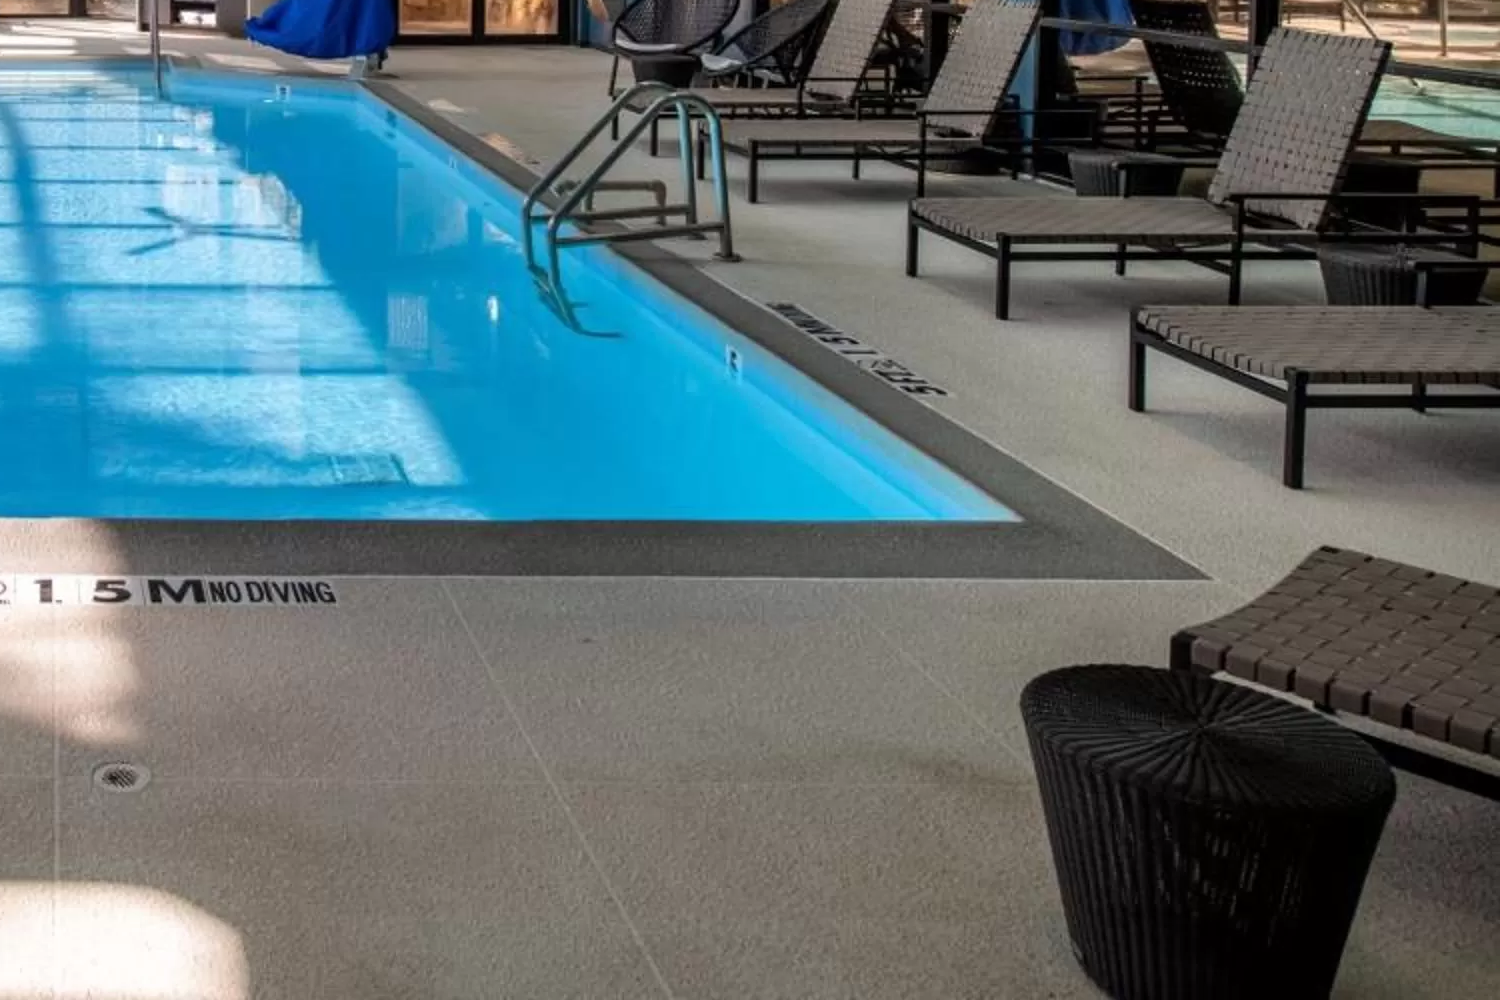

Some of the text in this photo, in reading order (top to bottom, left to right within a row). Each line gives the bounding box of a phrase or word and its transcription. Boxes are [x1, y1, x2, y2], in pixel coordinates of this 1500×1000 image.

[148, 579, 206, 603] M
[208, 580, 242, 603] NO
[244, 580, 336, 603] DIVING
